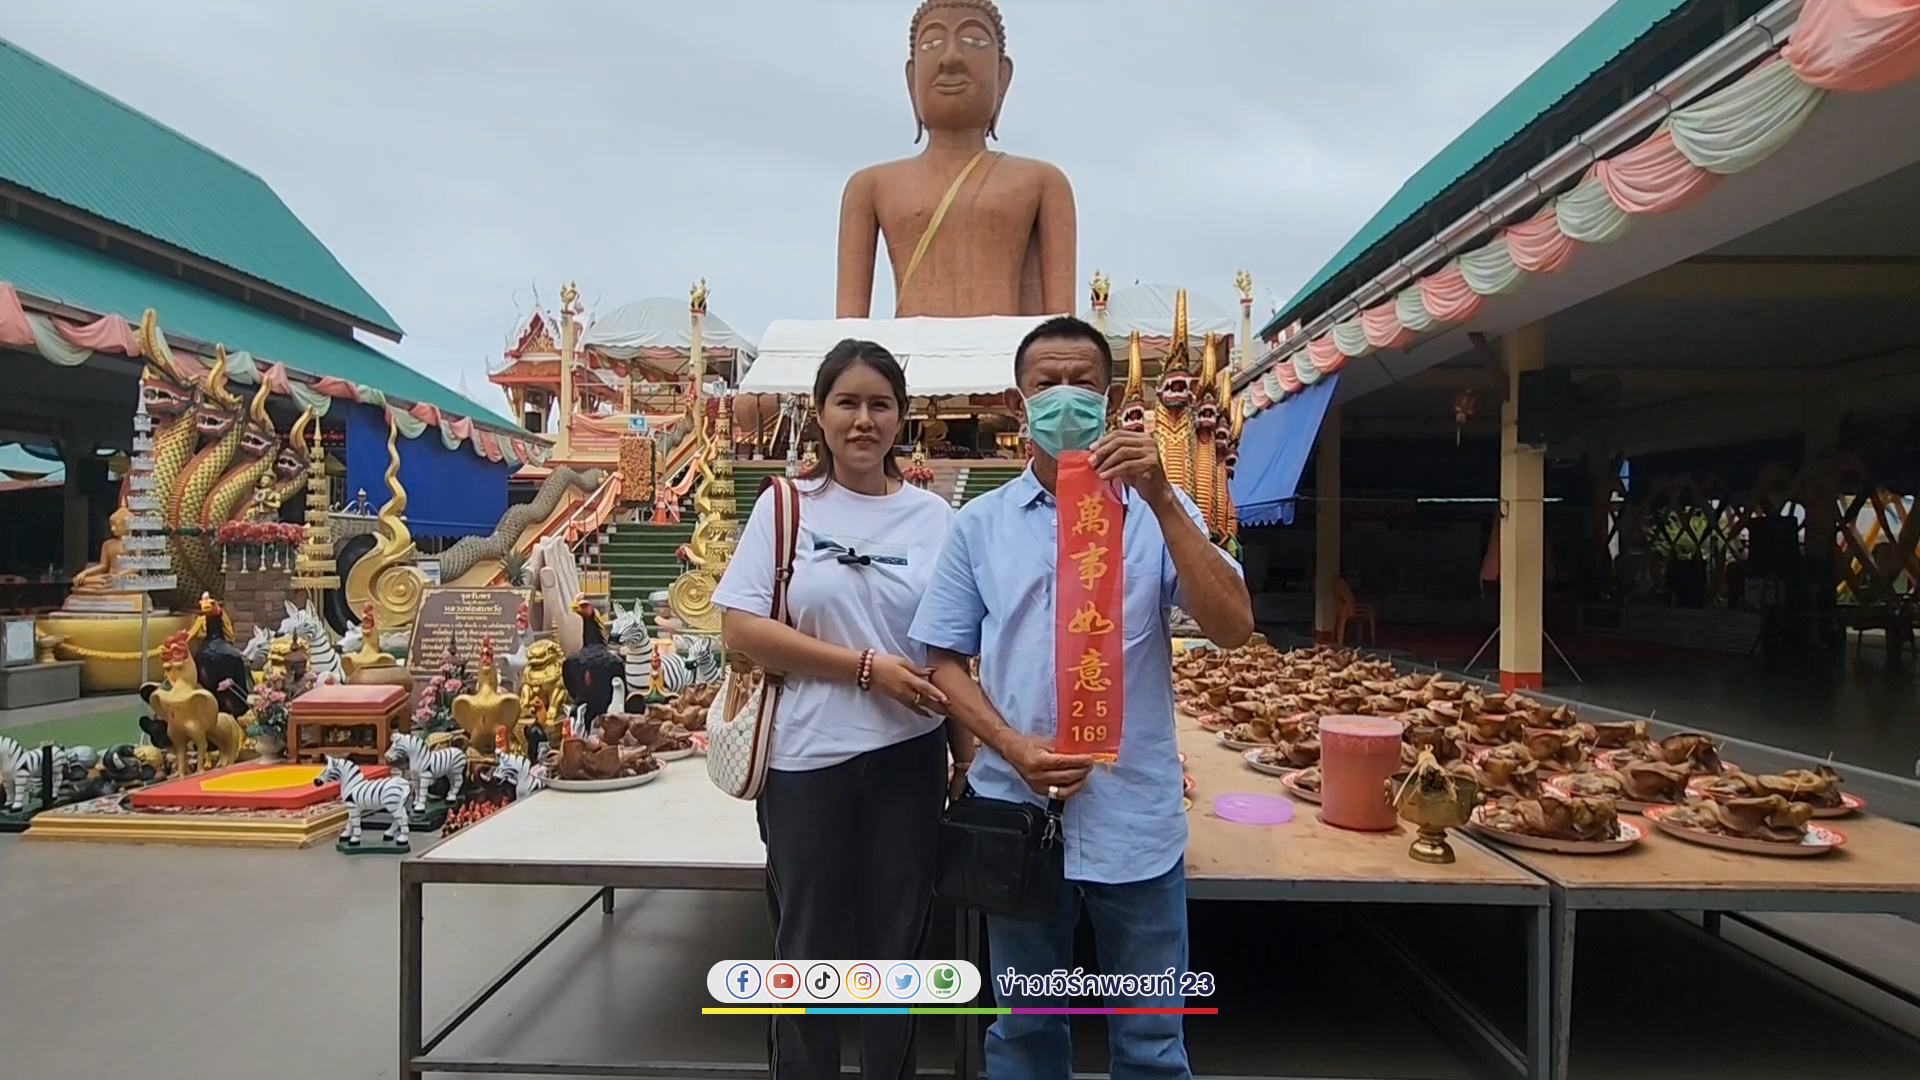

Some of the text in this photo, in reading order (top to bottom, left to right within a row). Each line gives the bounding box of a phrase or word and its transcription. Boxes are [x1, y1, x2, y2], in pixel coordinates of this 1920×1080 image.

[1069, 495, 1115, 690] 萬事如意
[1071, 725, 1107, 742] 169
